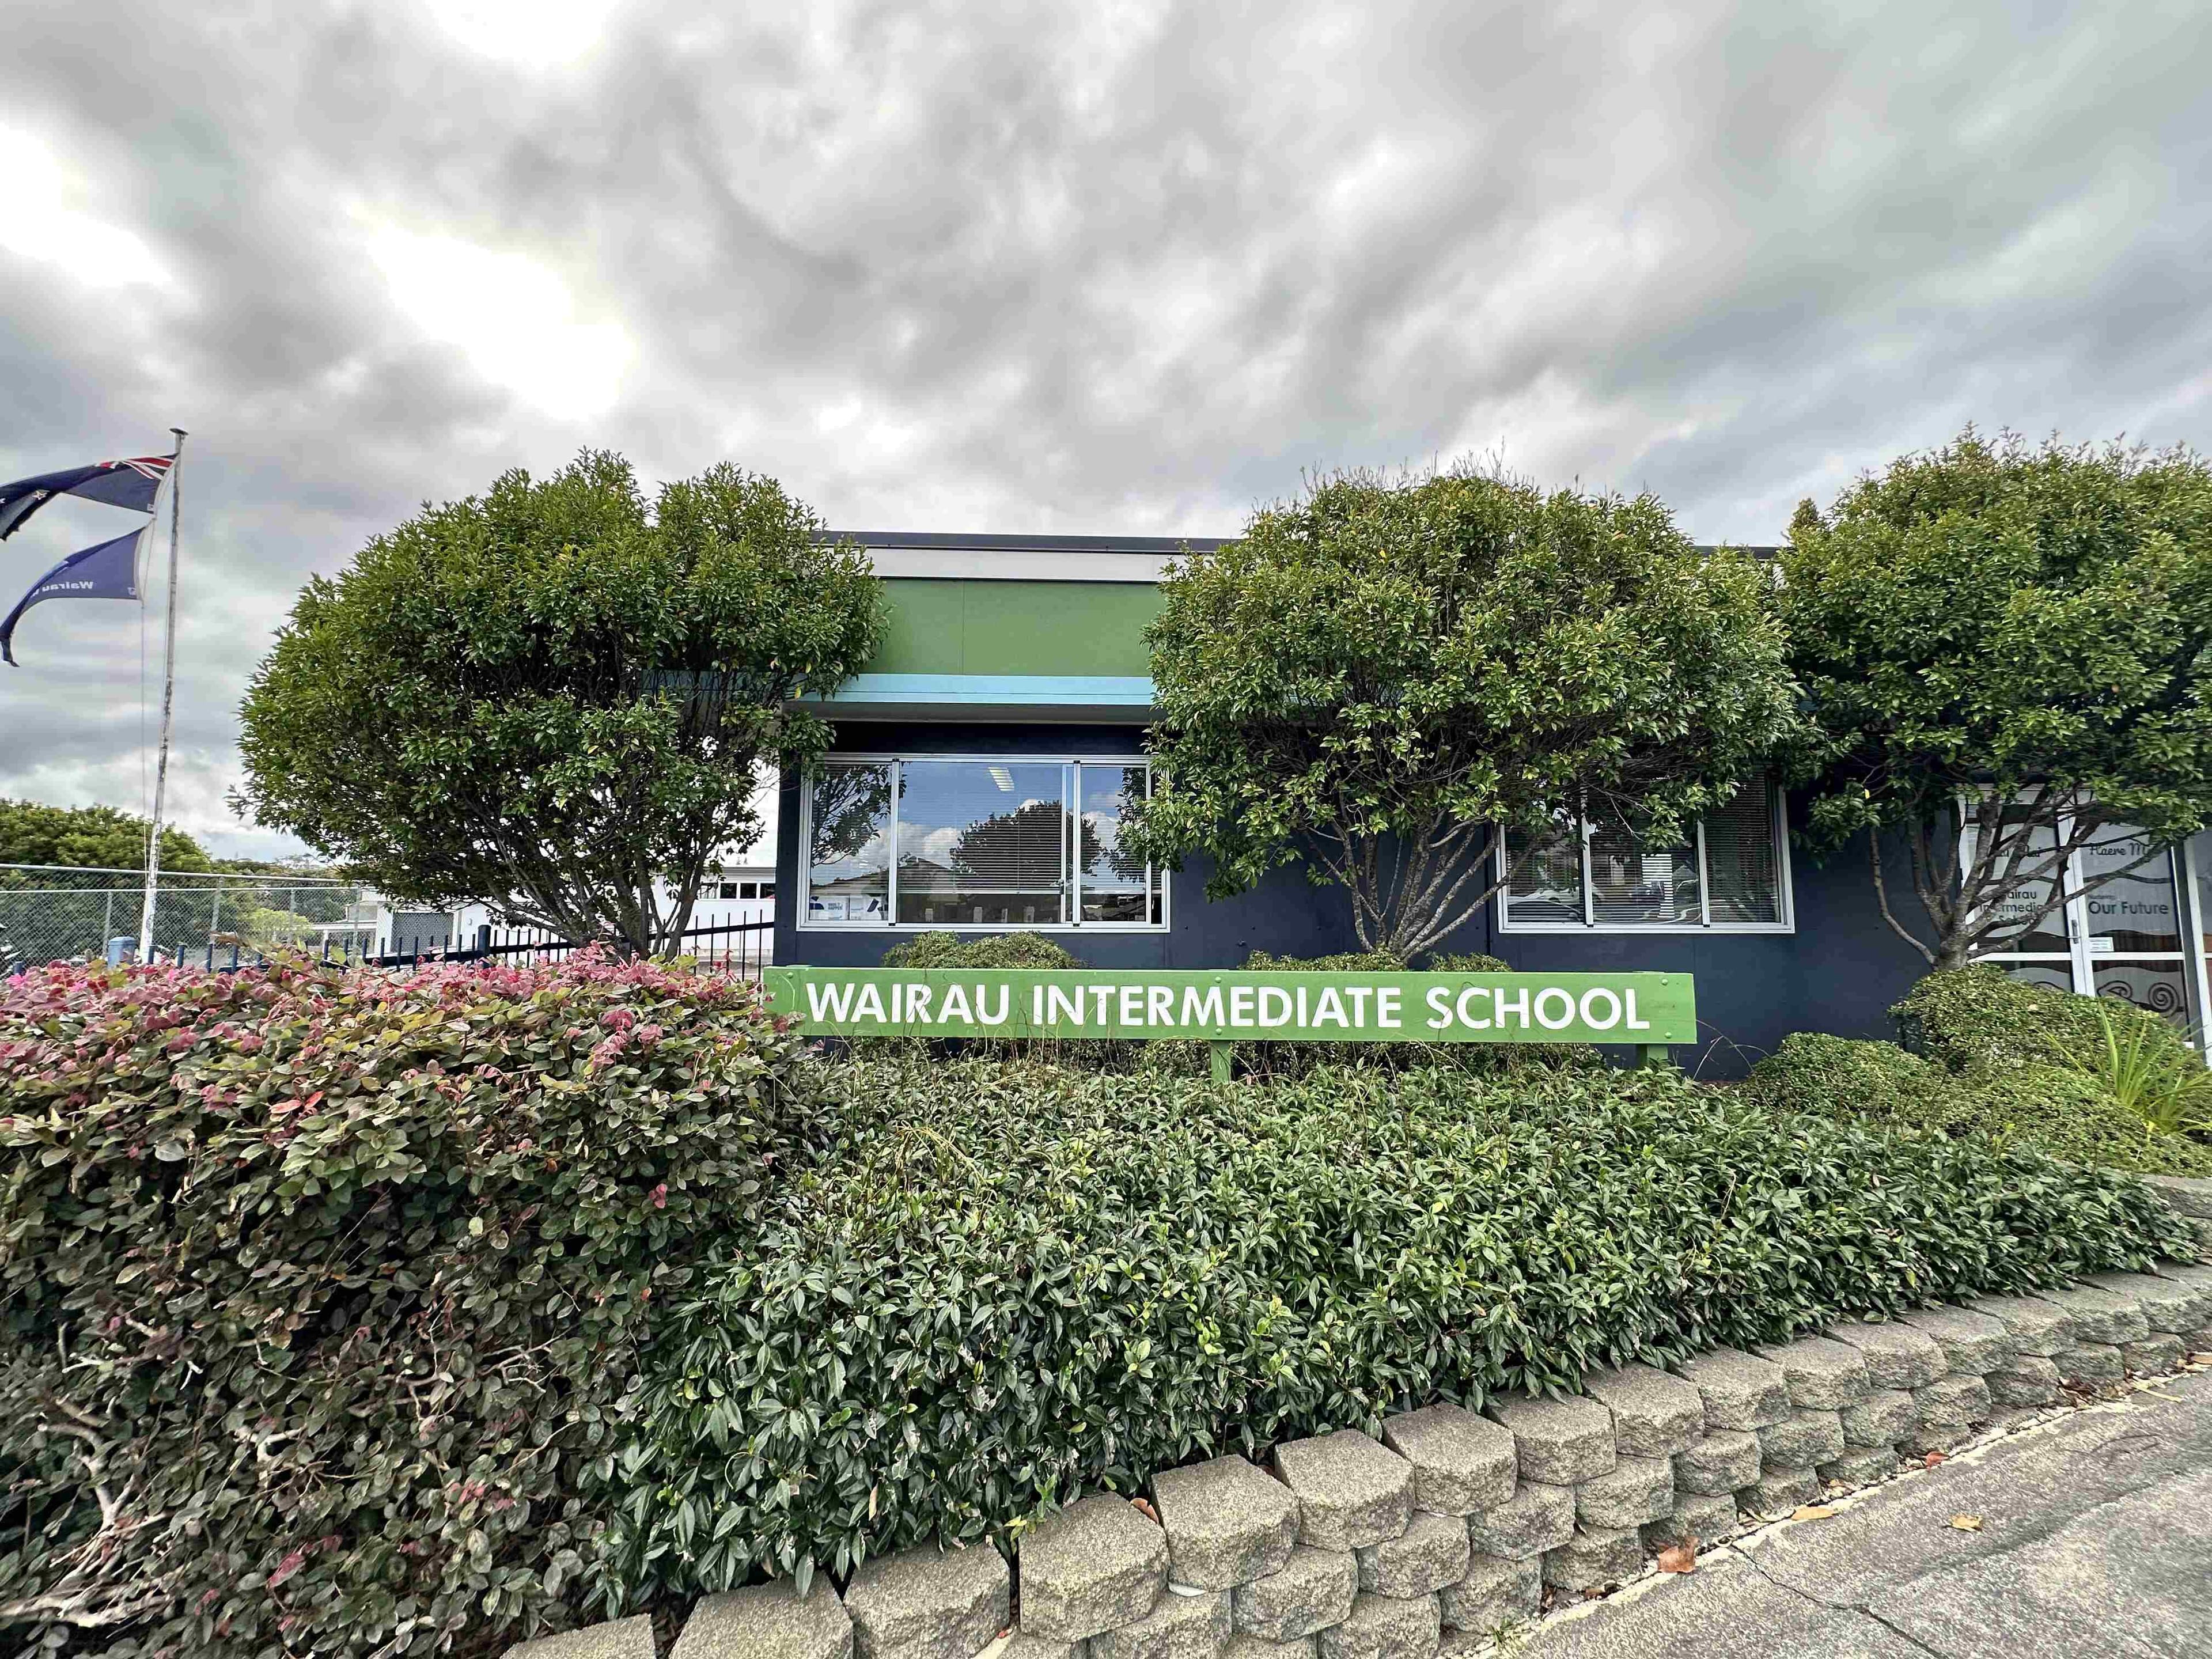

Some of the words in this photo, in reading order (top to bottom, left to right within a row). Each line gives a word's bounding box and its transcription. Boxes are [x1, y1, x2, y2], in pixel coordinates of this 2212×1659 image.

[2007, 889, 2037, 899] airau
[2088, 901, 2116, 914] Our
[2121, 901, 2168, 914] Future
[806, 983, 1009, 1025] WAIRAU
[1032, 985, 1402, 1028] INTERMEDIATE
[1426, 986, 1650, 1030] SCHOOL
